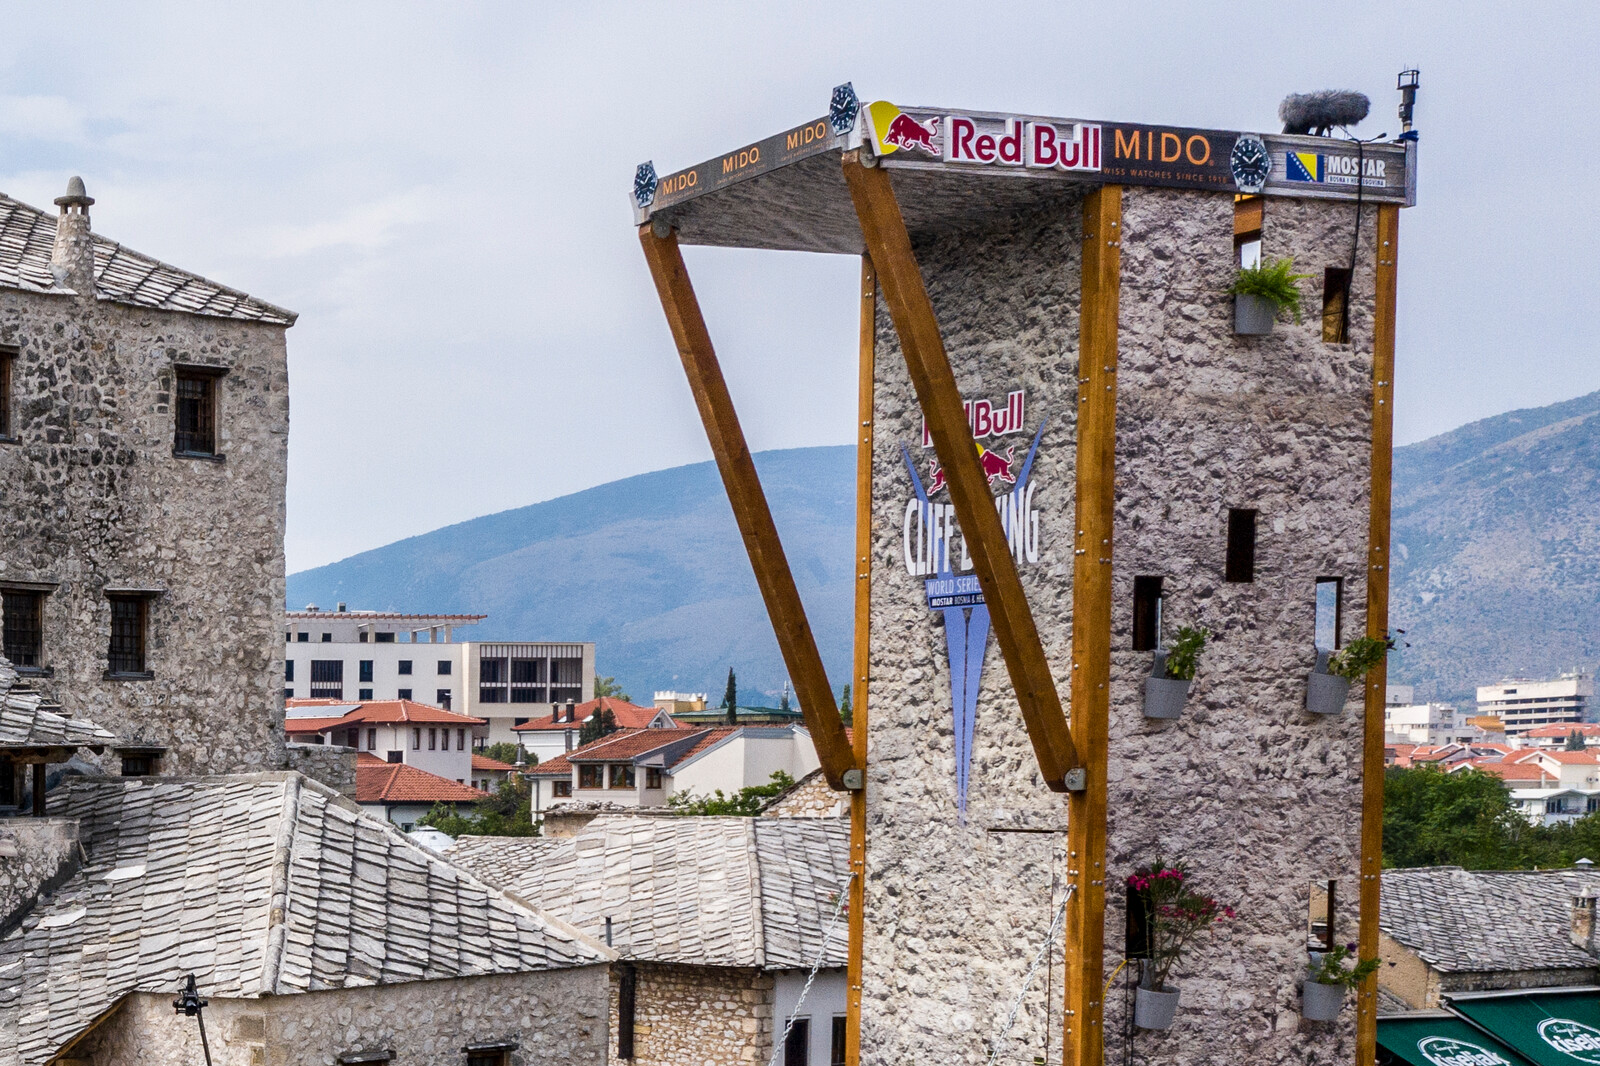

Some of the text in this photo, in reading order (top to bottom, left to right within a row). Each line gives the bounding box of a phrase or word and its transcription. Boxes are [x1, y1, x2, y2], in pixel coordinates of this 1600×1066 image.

[787, 122, 826, 150] MIDO
[950, 117, 1101, 171] Red Bull
[1114, 129, 1211, 166] MIDO
[722, 147, 760, 174] MIDO
[1100, 166, 1126, 176] WISS
[1130, 169, 1172, 180] WATCHES
[1176, 172, 1204, 182] SINCE
[1328, 155, 1386, 177] MOSTAR
[663, 170, 698, 196] MIDO
[974, 391, 1024, 438] Bull
[903, 497, 955, 576] CLIFF
[927, 576, 983, 596] WORLD SERIE
